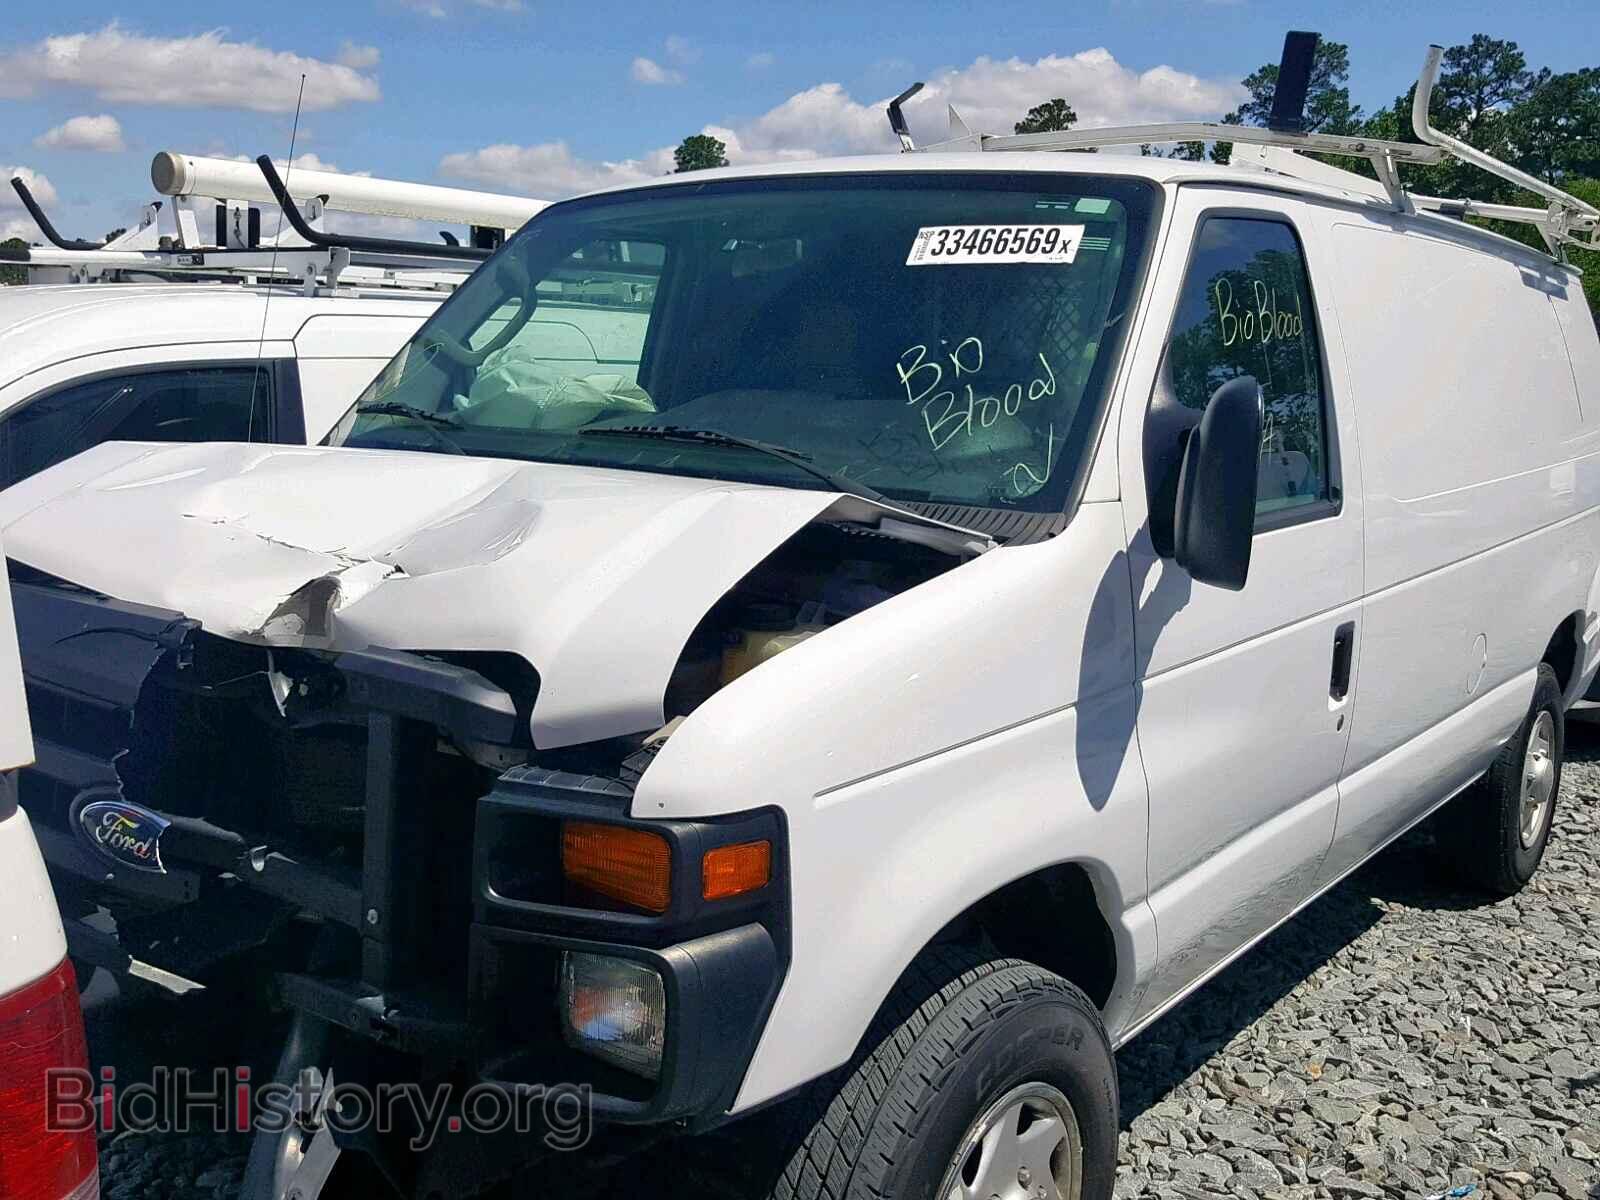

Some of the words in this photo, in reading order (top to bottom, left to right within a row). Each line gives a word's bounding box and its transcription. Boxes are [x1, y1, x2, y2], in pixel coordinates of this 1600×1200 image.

[896, 337, 983, 405] Bio
[922, 353, 1055, 451] Blood
[95, 811, 153, 859] Ford
